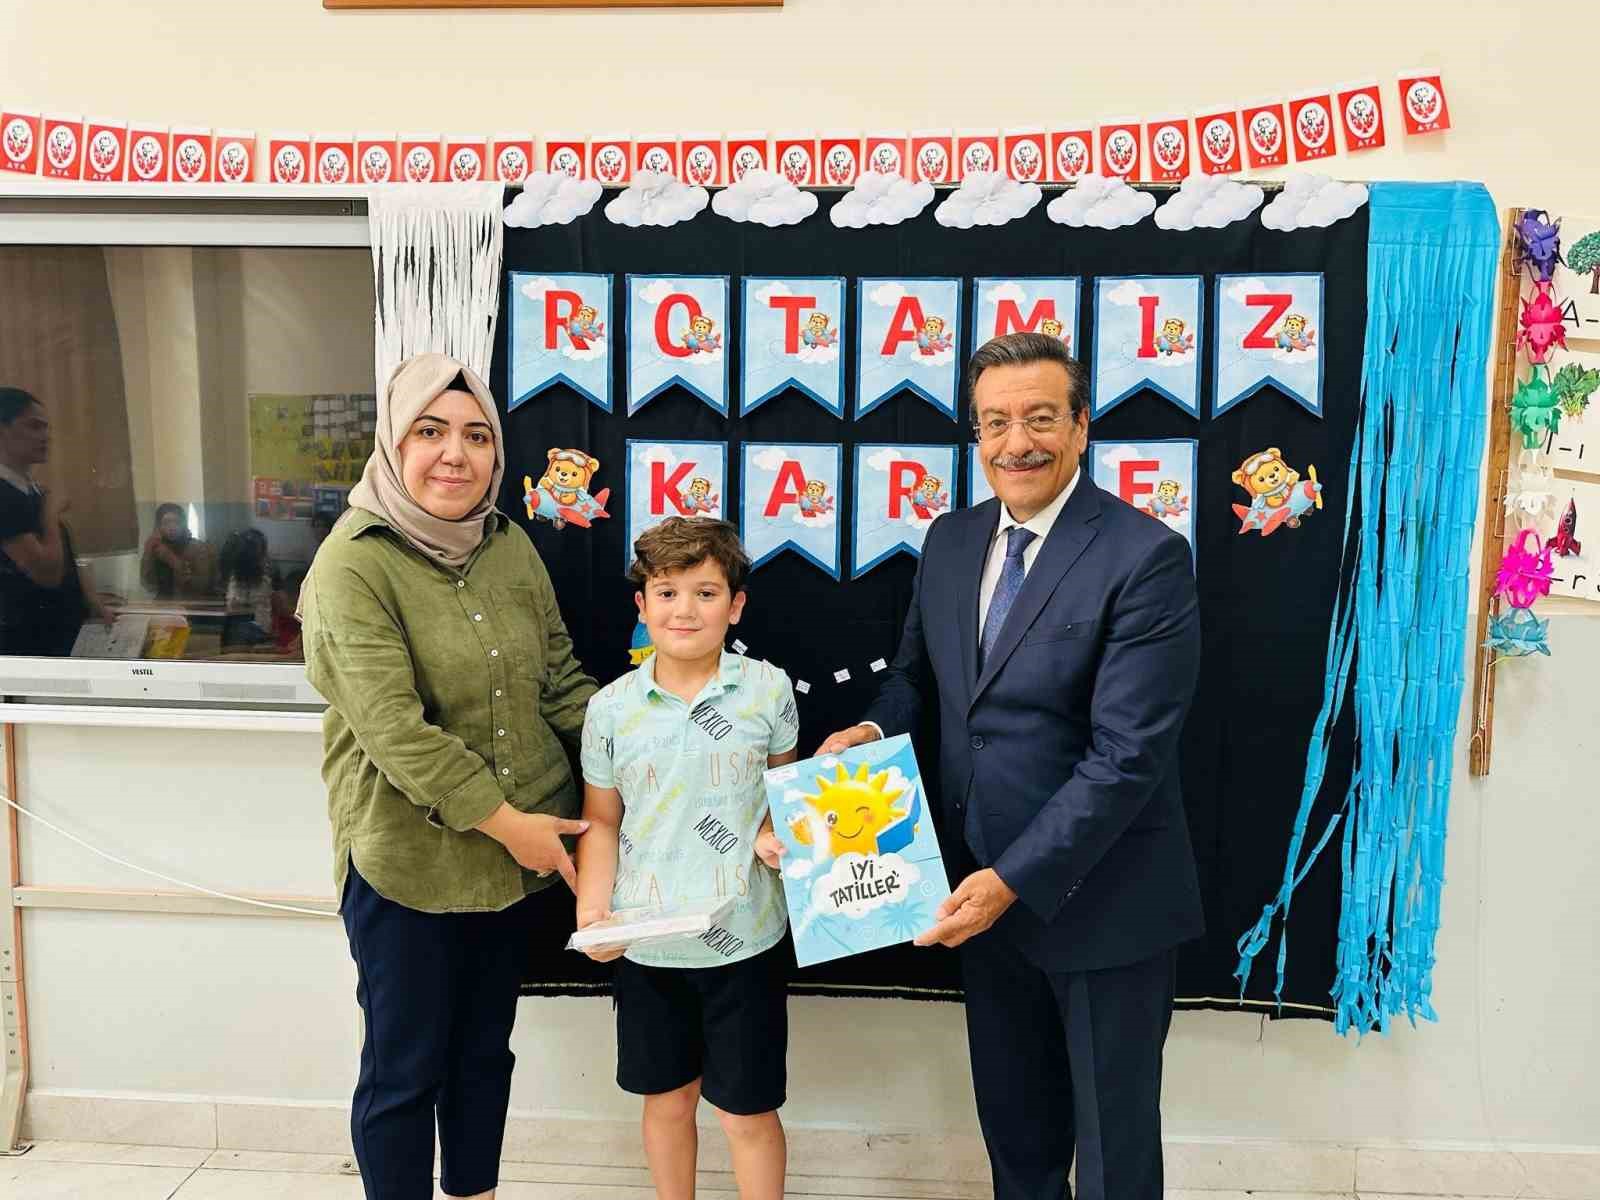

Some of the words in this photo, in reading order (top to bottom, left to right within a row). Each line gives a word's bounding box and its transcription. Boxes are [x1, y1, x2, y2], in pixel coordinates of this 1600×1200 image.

[649, 459, 1160, 520] KARE
[689, 702, 733, 741] MEXICO
[692, 813, 739, 855] MEXICO
[697, 922, 745, 957] MEXICO
